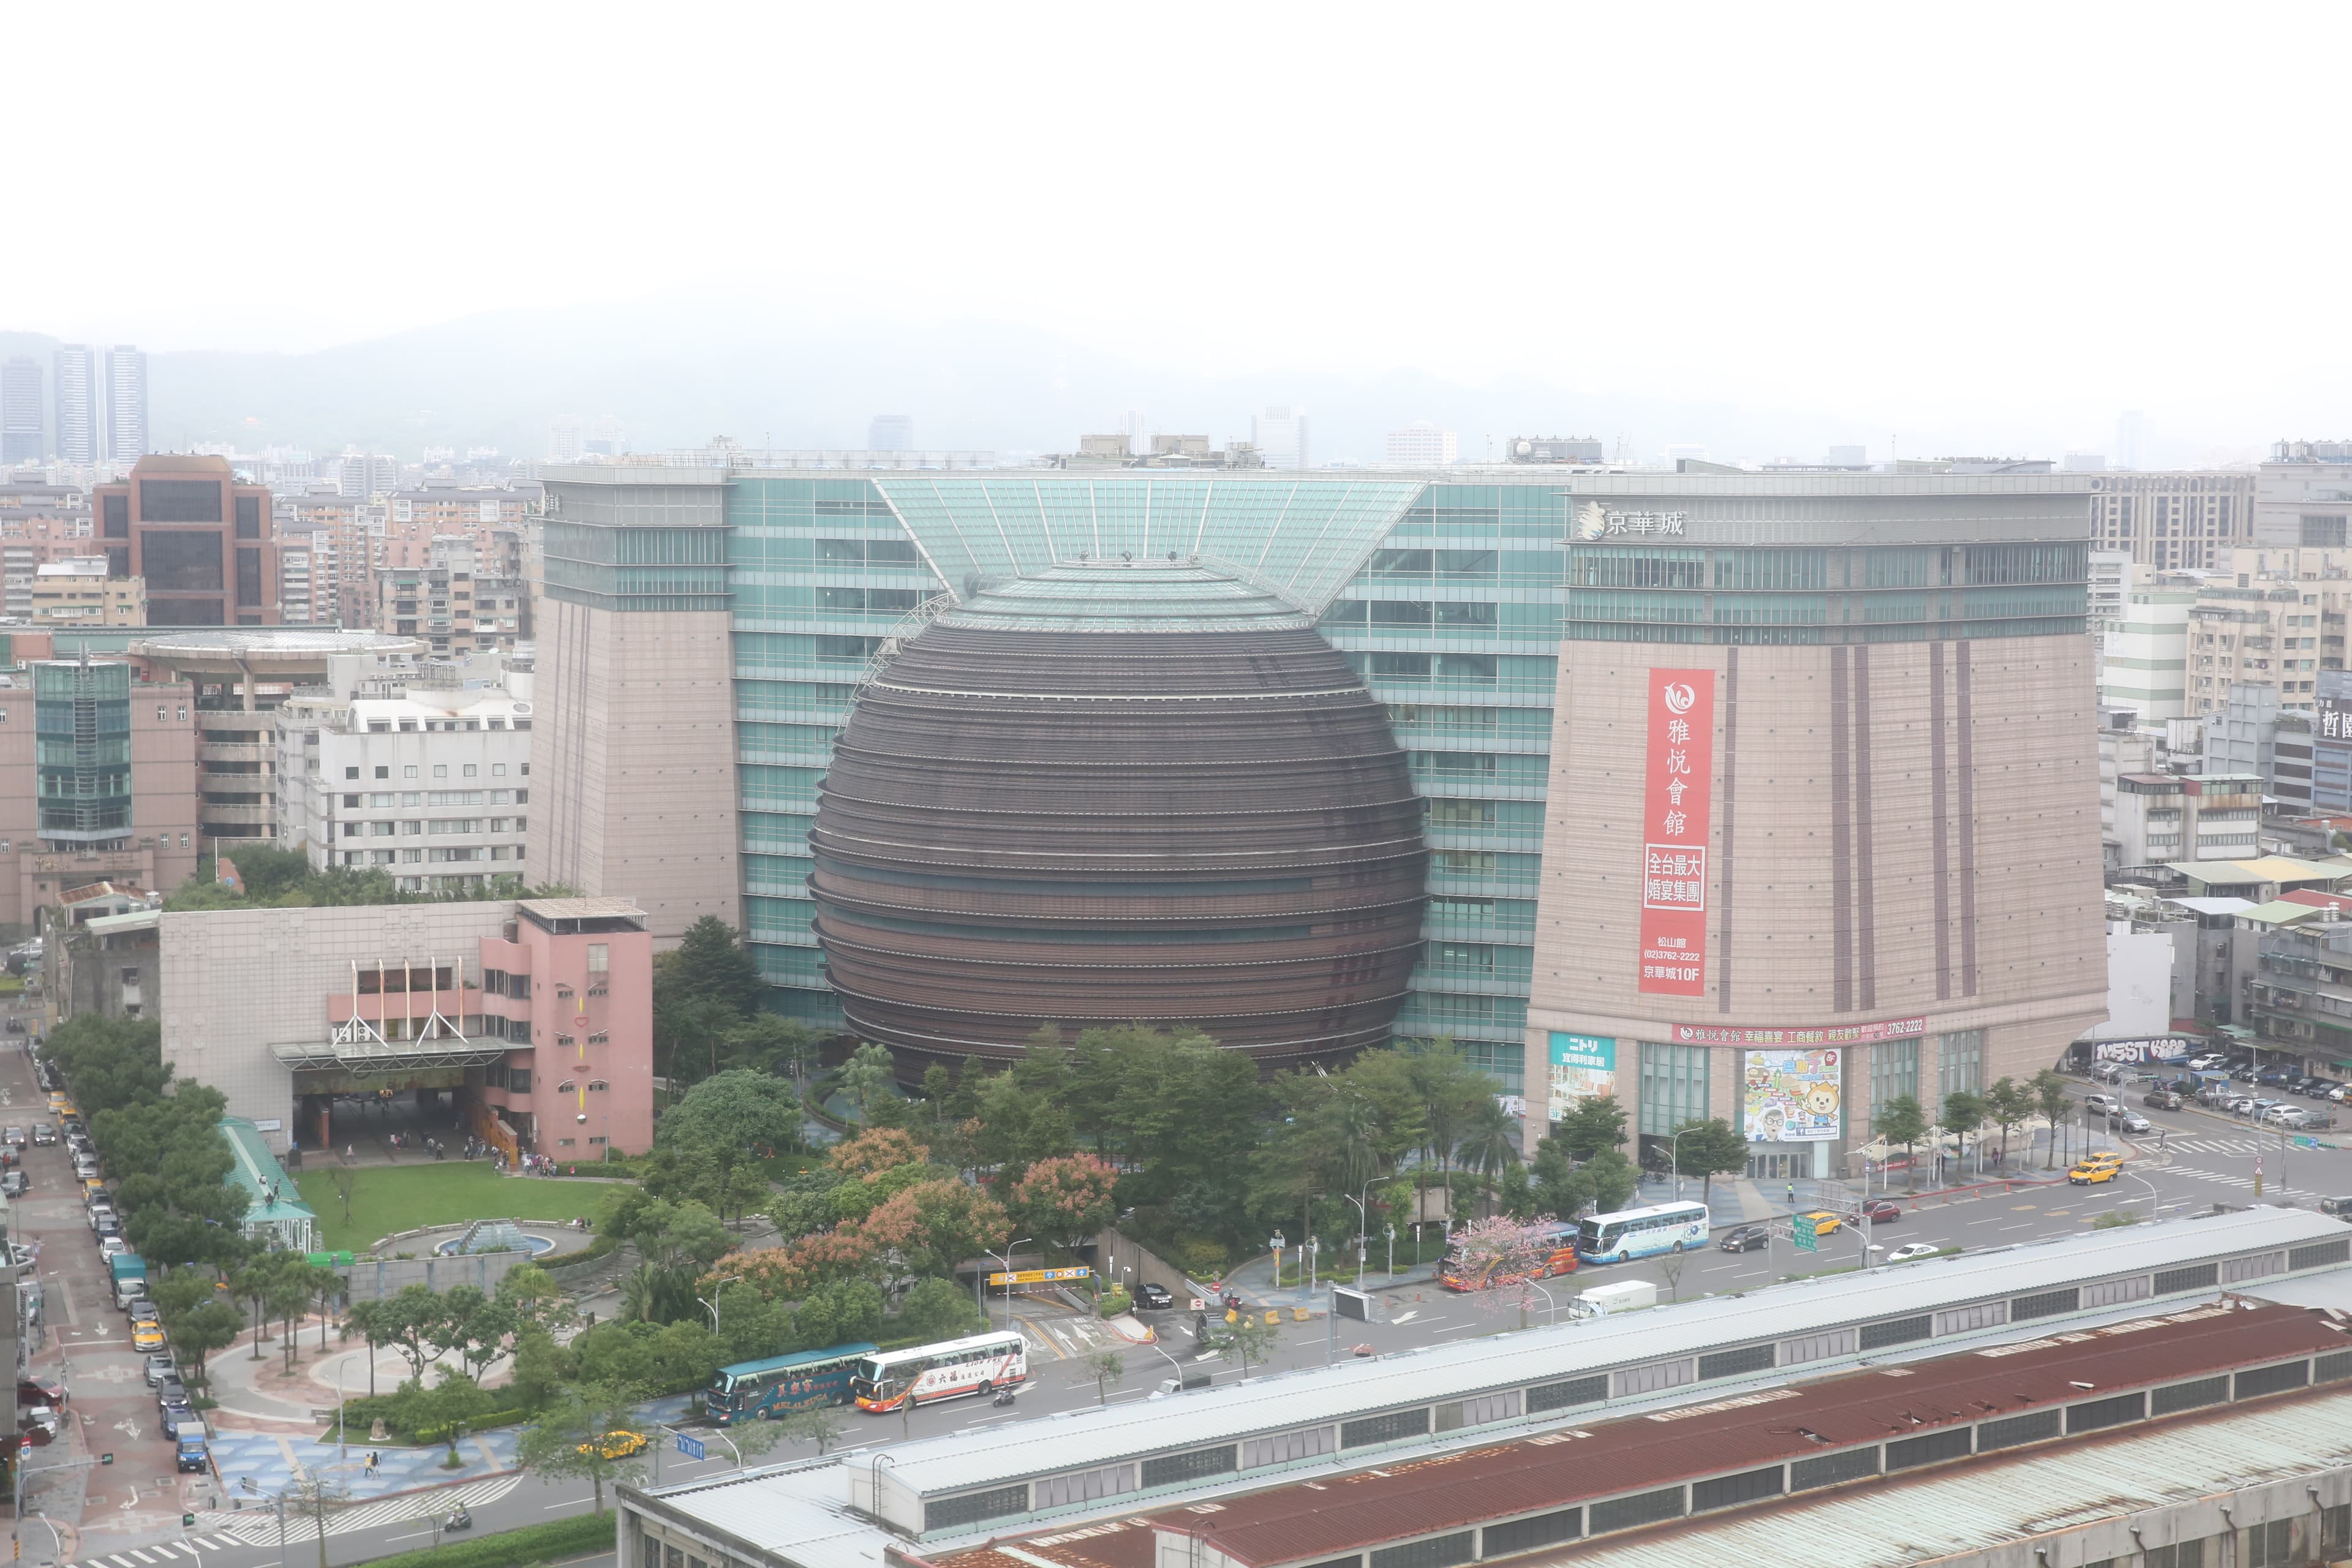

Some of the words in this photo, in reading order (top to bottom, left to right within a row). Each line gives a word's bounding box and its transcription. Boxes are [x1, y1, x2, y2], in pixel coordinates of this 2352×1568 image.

[1606, 510, 1683, 535] 京華城
[1663, 717, 1692, 837] 雅悅會館
[1649, 853, 1701, 876] 全台最大
[1648, 879, 1700, 903] 婚宴集團
[1657, 936, 1686, 948] 松山館
[1644, 950, 1700, 962] (02)3762-2222
[1643, 965, 1700, 981] 京華城10F
[1887, 1019, 1923, 1036] 3762-2222
[1569, 1038, 1598, 1053] ニトリ
[2096, 1041, 2149, 1062] NEST
[1562, 1052, 1605, 1067] 宜得利家居
[1826, 1054, 1836, 1062] 8F
